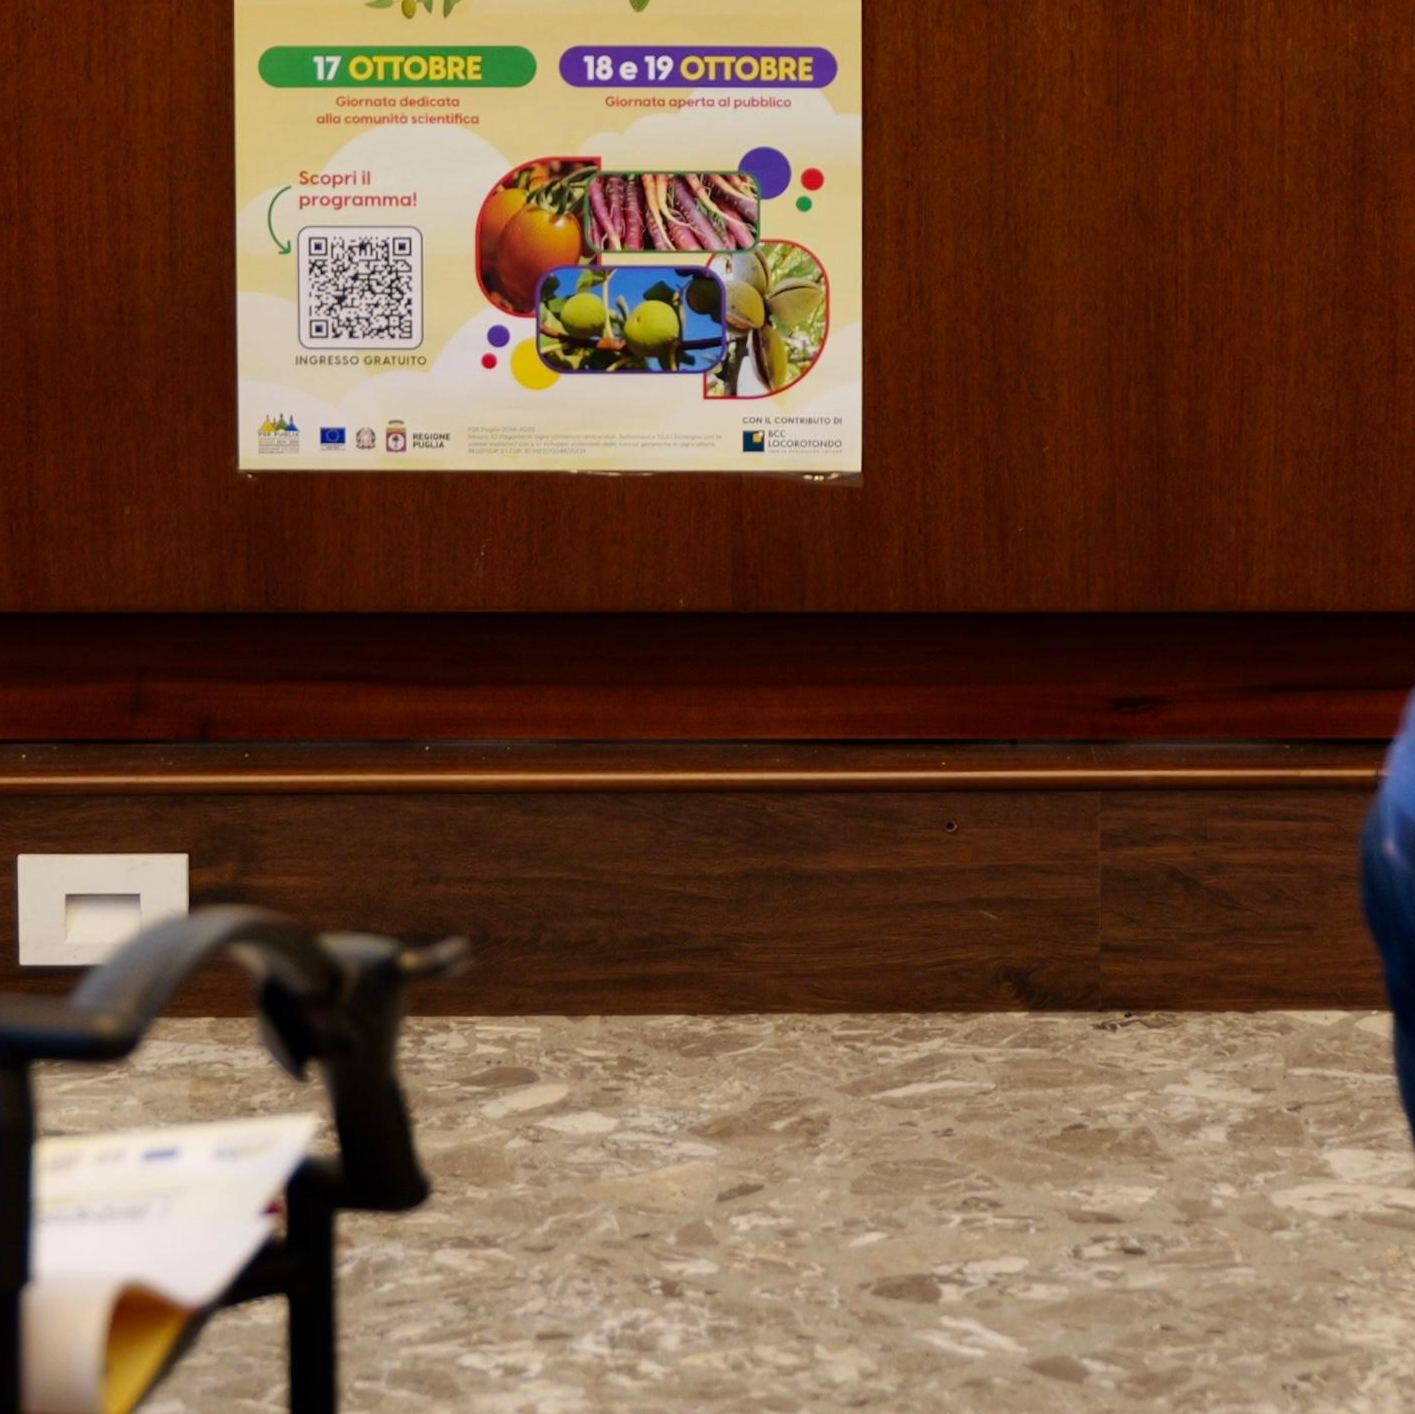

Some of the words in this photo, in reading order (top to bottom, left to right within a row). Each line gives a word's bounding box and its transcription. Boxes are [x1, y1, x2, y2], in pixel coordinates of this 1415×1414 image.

[314, 56, 341, 81] 17
[349, 56, 482, 81] OTTOBRE
[584, 56, 614, 81] 18
[619, 61, 636, 81] e
[645, 56, 674, 81] 19
[680, 56, 813, 81] OTTOBRE
[336, 96, 397, 107] Giornata
[399, 96, 460, 107] dedicata
[605, 96, 666, 107] Giornata
[669, 98, 714, 110] aperta
[718, 97, 730, 107] al
[734, 97, 792, 110] pubblico
[316, 114, 341, 124] alla
[344, 113, 409, 124] comunità
[411, 113, 479, 124] scientifica
[299, 170, 357, 188] Scopri
[361, 171, 371, 185] il
[299, 192, 417, 210] programma!
[295, 355, 360, 366] INGRESSO
[364, 355, 427, 366] GRATUITO
[413, 433, 450, 441] REGIONE
